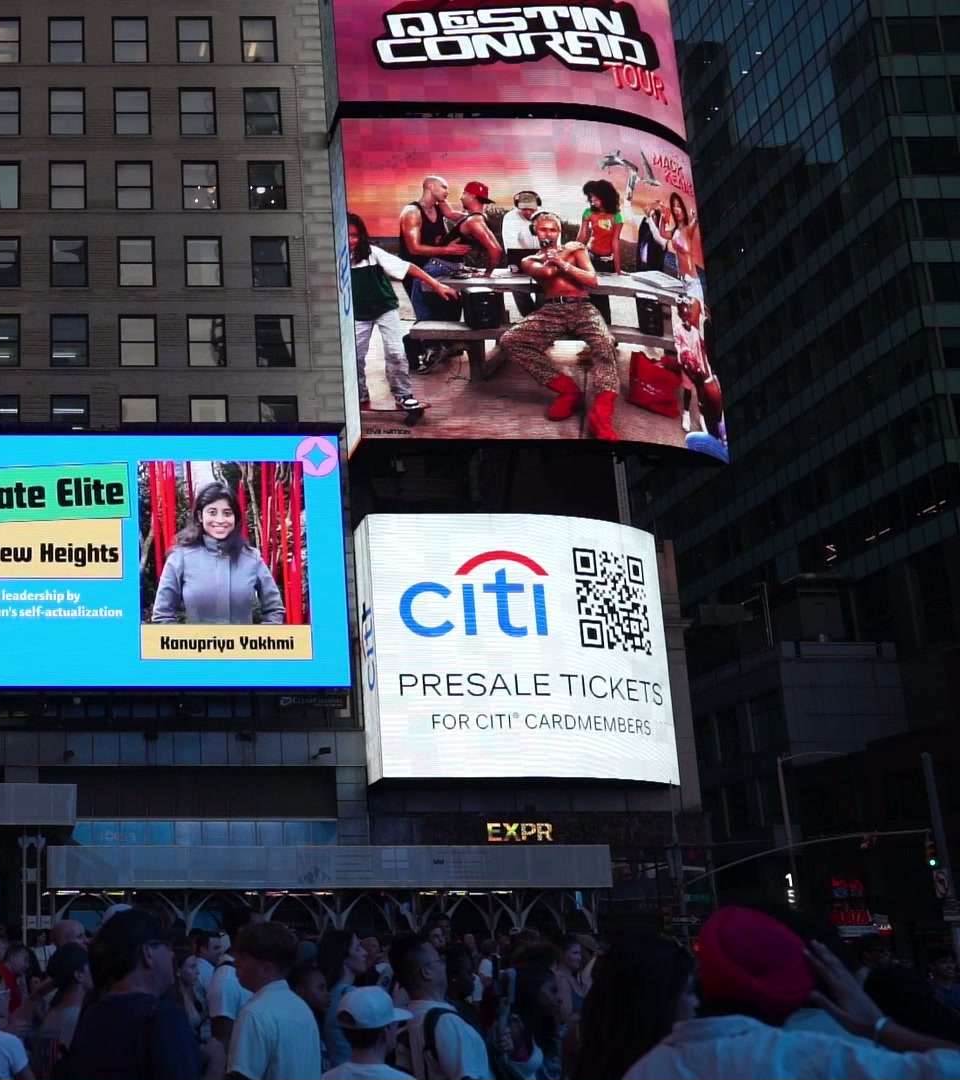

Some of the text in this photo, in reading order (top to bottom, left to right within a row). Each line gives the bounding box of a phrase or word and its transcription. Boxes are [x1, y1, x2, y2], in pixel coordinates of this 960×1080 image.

[385, 5, 627, 38] DESTIN
[376, 30, 647, 66] CONRAD
[603, 61, 668, 105] TOUR
[57, 477, 125, 507] Elite
[40, 542, 119, 567] Heights
[2, 589, 64, 603] leadership
[66, 589, 81, 603] by
[399, 550, 549, 638] citi
[19, 605, 123, 618] self-actualization
[160, 635, 295, 653] Kanupriya Yakhmi
[399, 673, 664, 706] PRESALE TICKETS
[432, 713, 470, 730] FOR
[525, 713, 652, 736] CARDMEMBERS
